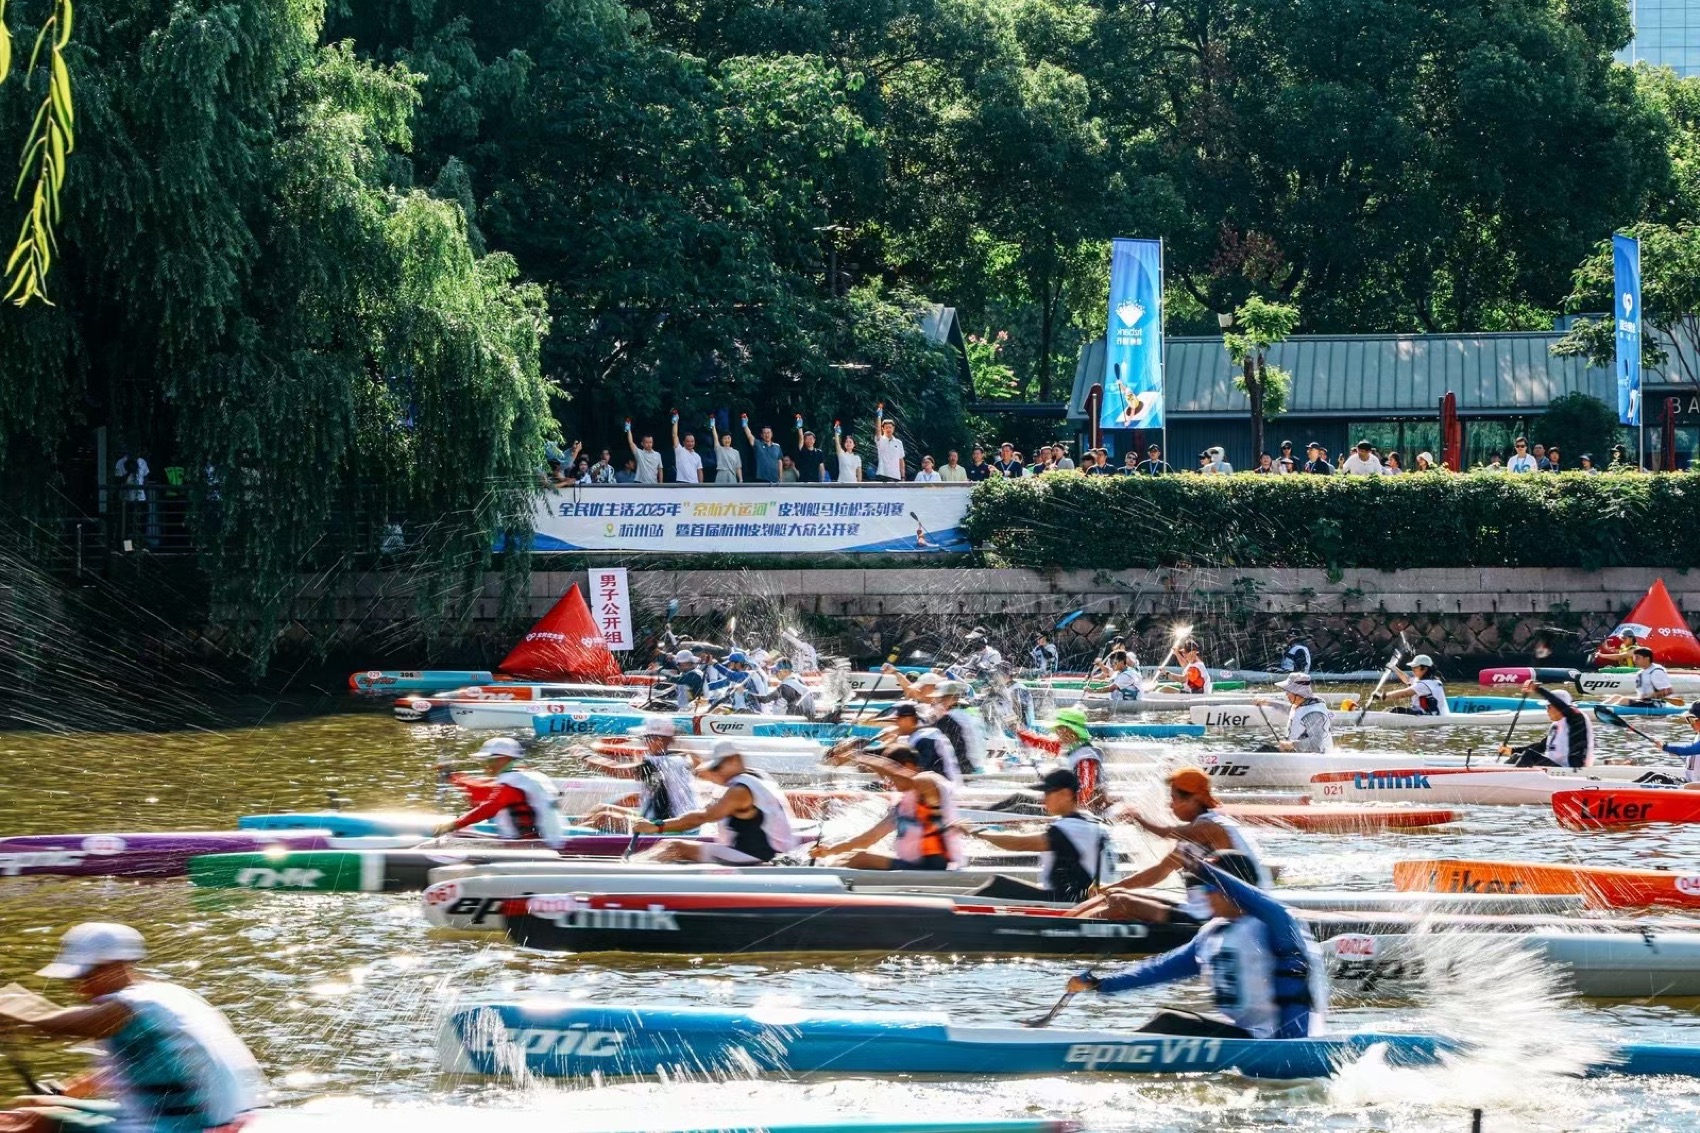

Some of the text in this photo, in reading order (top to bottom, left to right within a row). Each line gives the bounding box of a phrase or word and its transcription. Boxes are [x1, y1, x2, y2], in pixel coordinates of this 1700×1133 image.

[618, 523, 664, 537] 杭州站
[600, 574, 624, 644] 男子公开组
[1583, 680, 1621, 691] epic
[549, 718, 597, 733] Liker
[1206, 712, 1250, 726] Liker
[716, 721, 744, 733] epic
[1354, 773, 1431, 789] think
[1323, 786, 1344, 795] 021
[1580, 798, 1653, 820] Liker
[1063, 1039, 1224, 1070] epic V11
